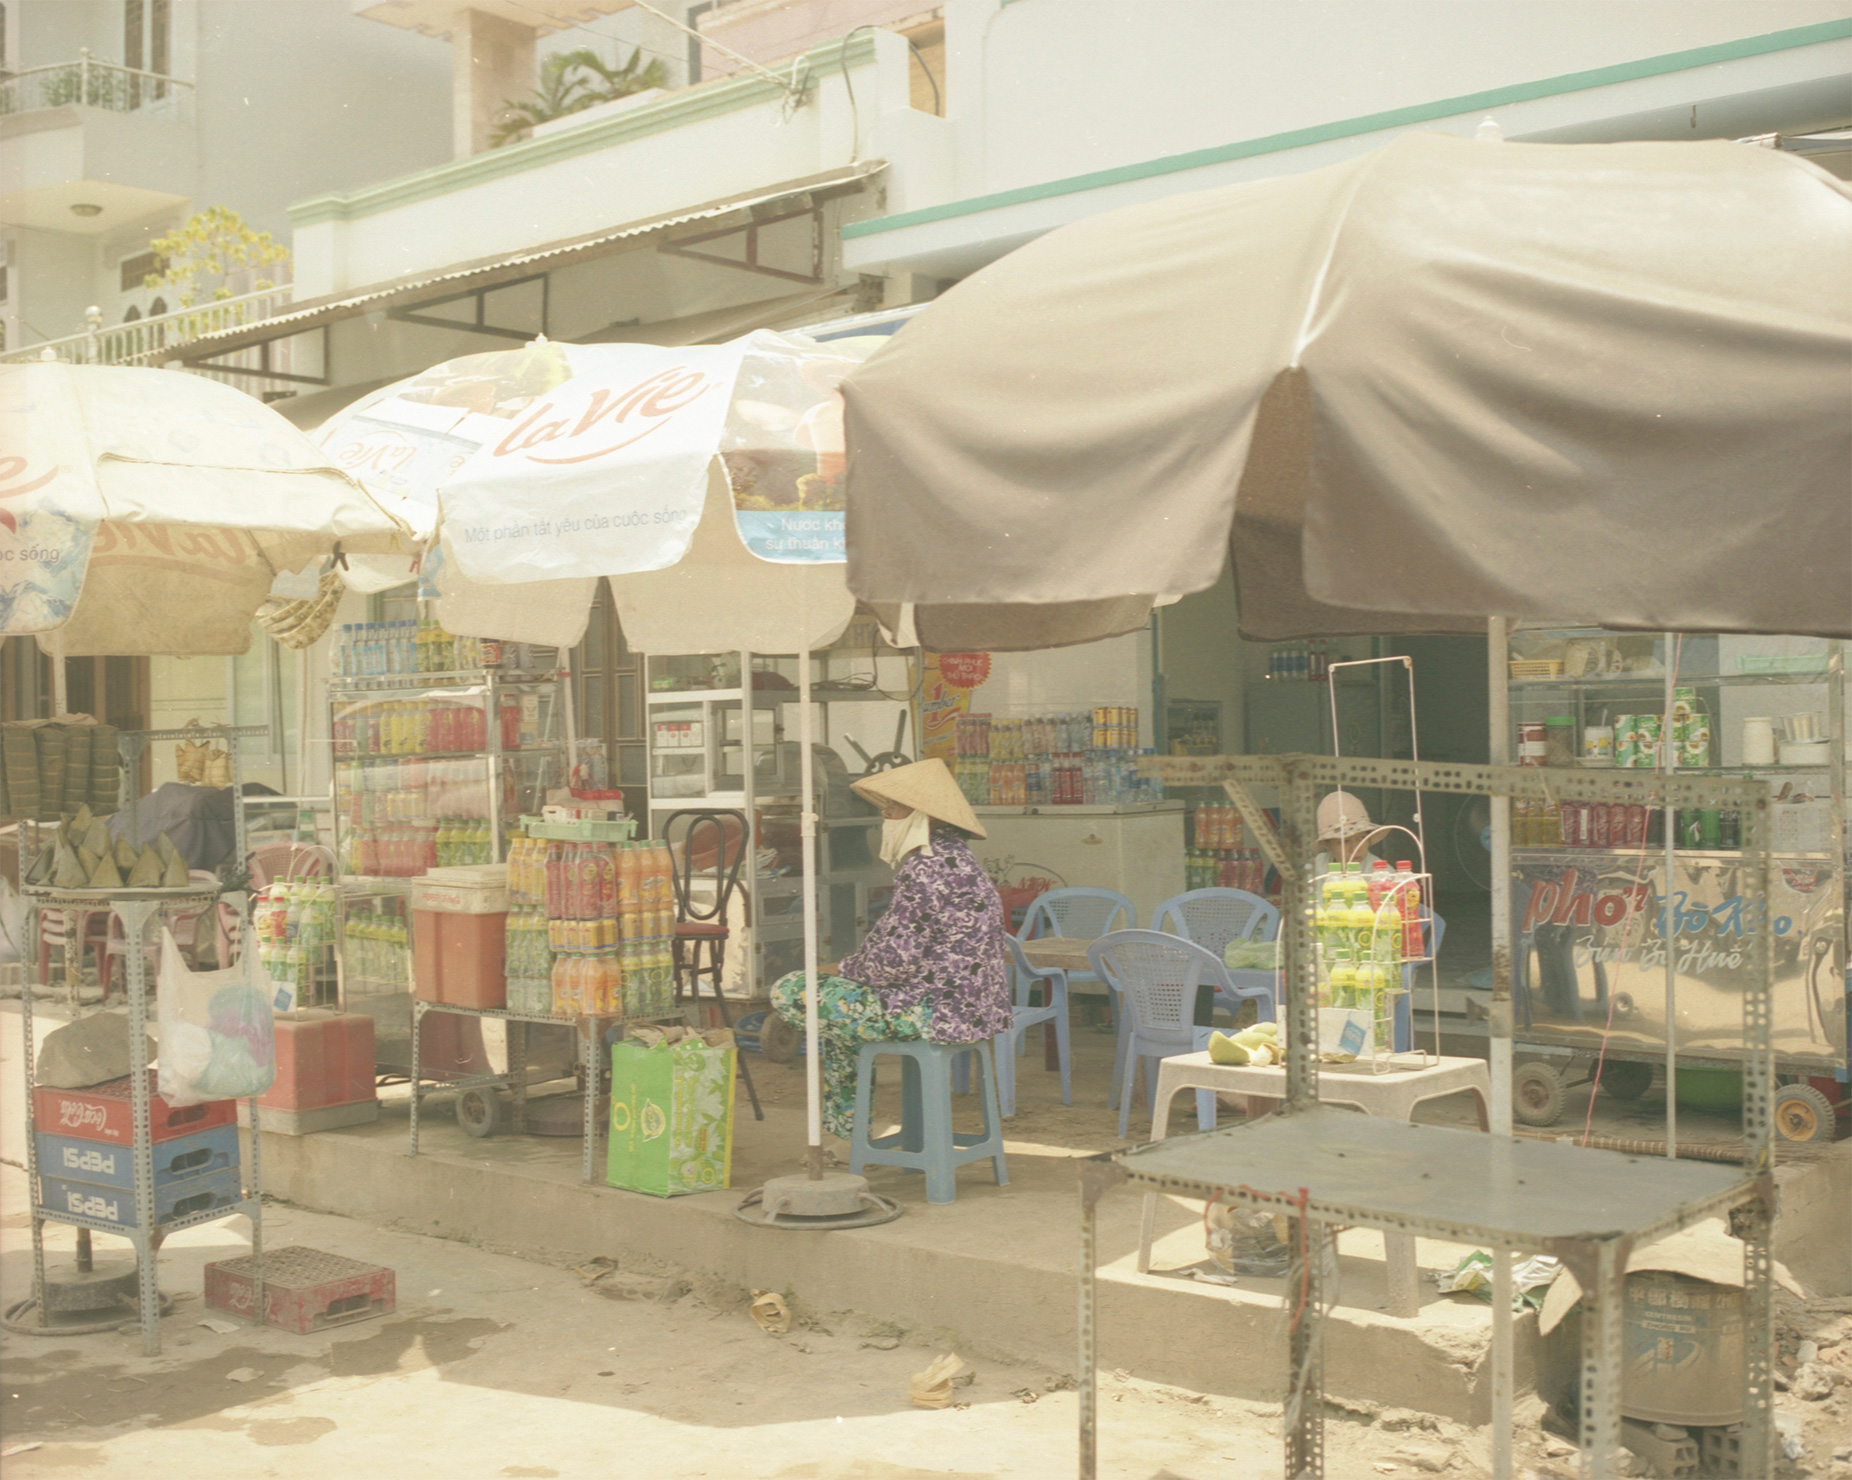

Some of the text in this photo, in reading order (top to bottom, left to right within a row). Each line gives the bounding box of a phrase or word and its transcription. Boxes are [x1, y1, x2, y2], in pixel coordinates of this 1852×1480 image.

[464, 526, 490, 545] Một
[20, 543, 60, 564] sống
[63, 1147, 115, 1175] PEPSI
[67, 1191, 118, 1221] PEPSI
